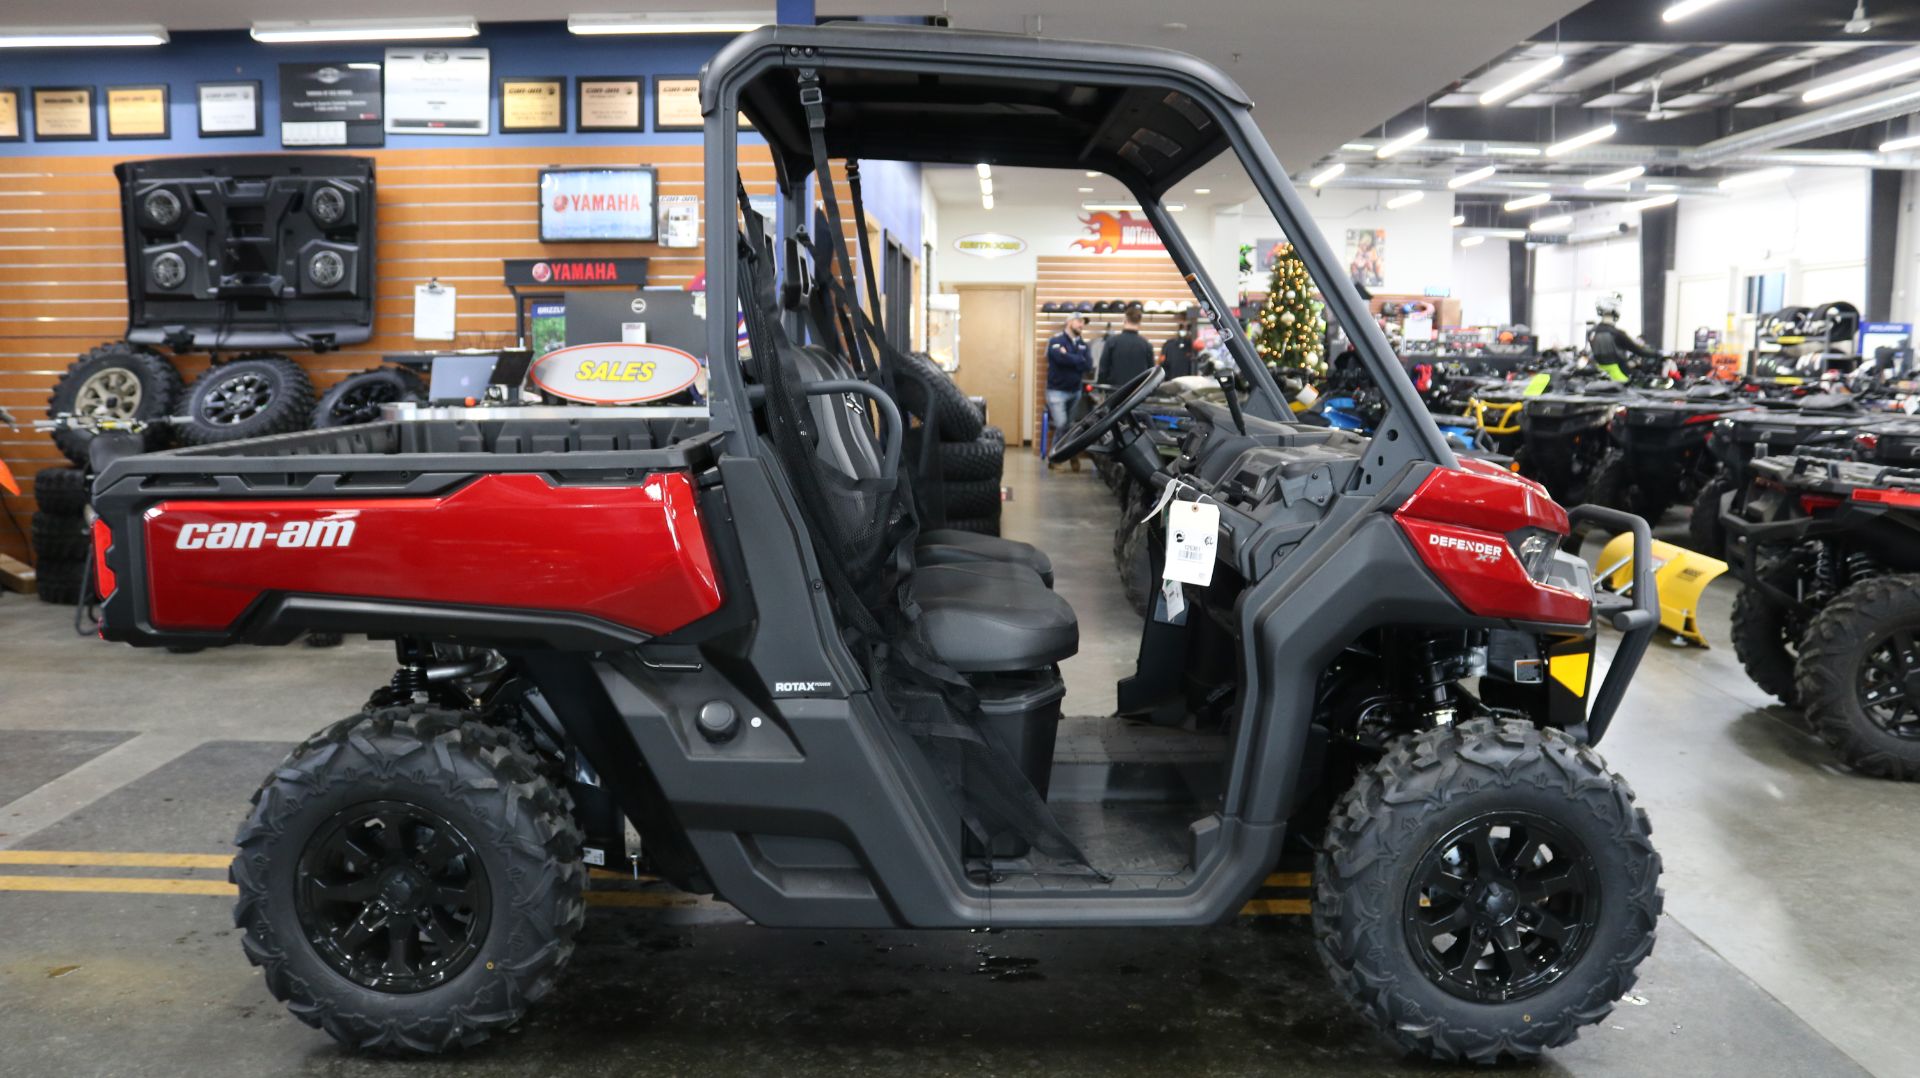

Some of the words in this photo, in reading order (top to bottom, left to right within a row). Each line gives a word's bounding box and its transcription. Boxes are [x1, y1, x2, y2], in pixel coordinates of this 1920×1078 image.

[571, 194, 640, 212] YAMAHA
[551, 262, 618, 280] YAMAHA
[575, 360, 656, 382] SALES
[176, 520, 356, 550] can-am
[1429, 533, 1502, 557] DEFENDER
[1476, 553, 1501, 563] XT
[775, 681, 815, 692] ROTAX
